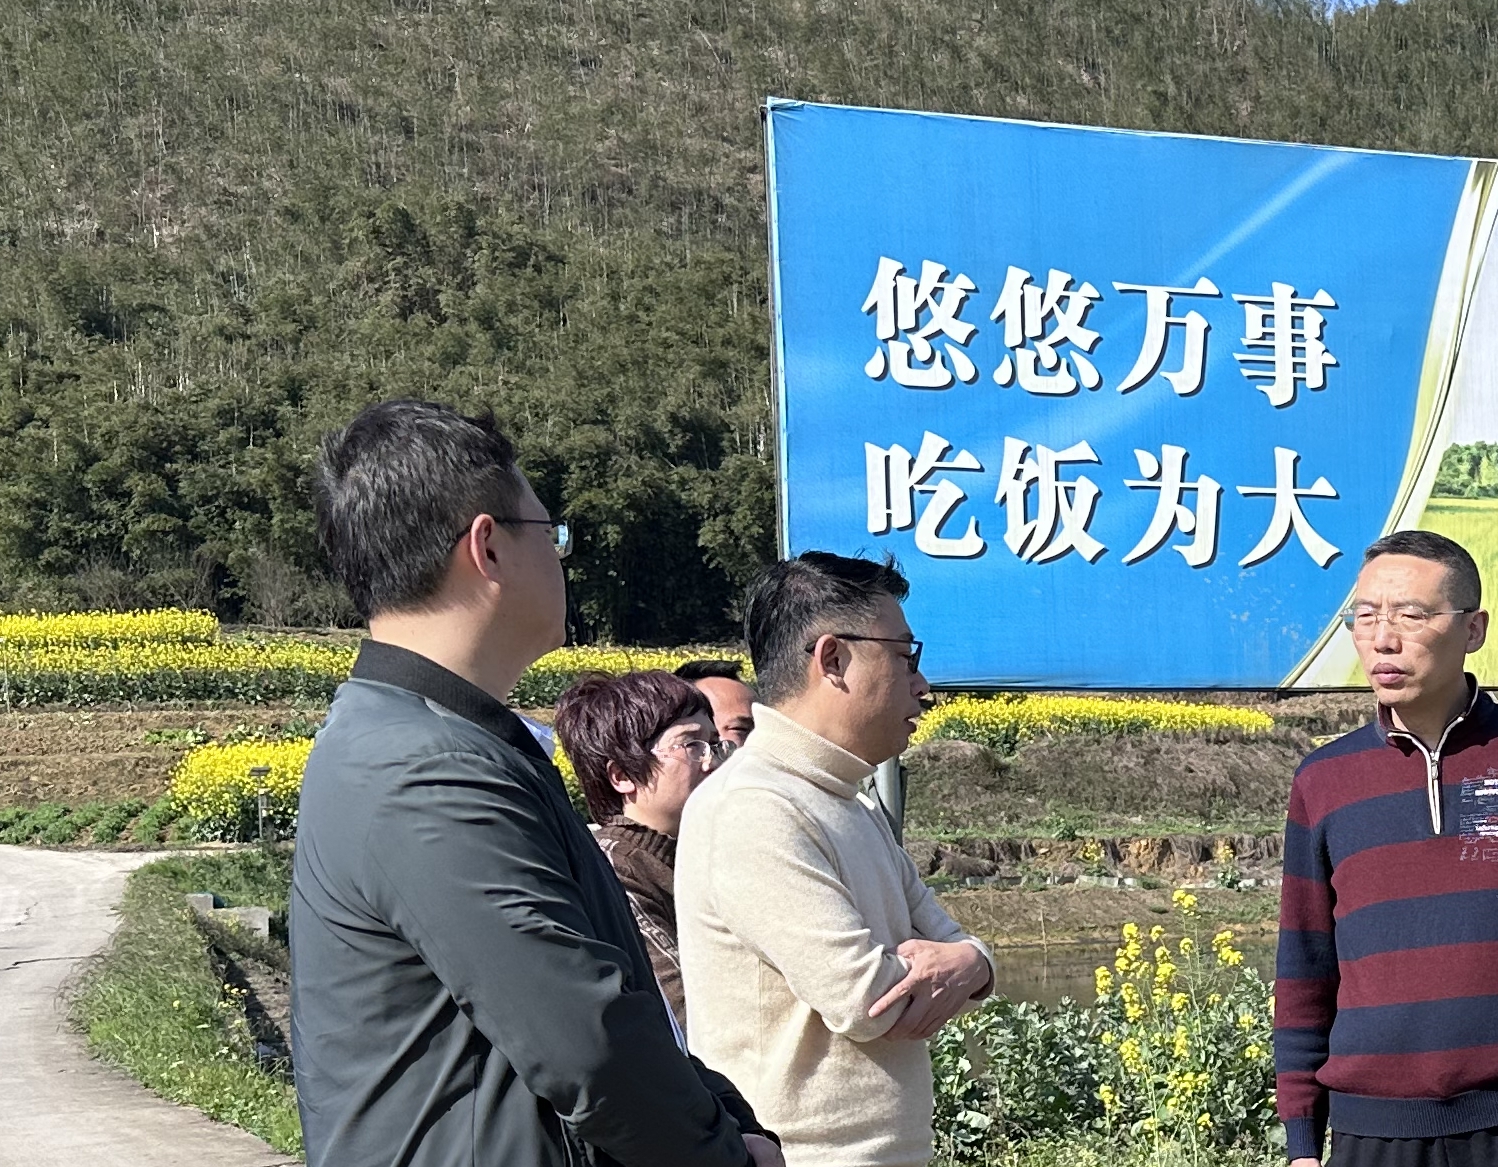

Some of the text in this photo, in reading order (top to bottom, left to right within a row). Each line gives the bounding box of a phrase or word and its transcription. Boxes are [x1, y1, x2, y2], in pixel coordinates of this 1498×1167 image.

[861, 256, 1338, 407] 悠悠万事
[864, 431, 1340, 567] 吃饭为大
